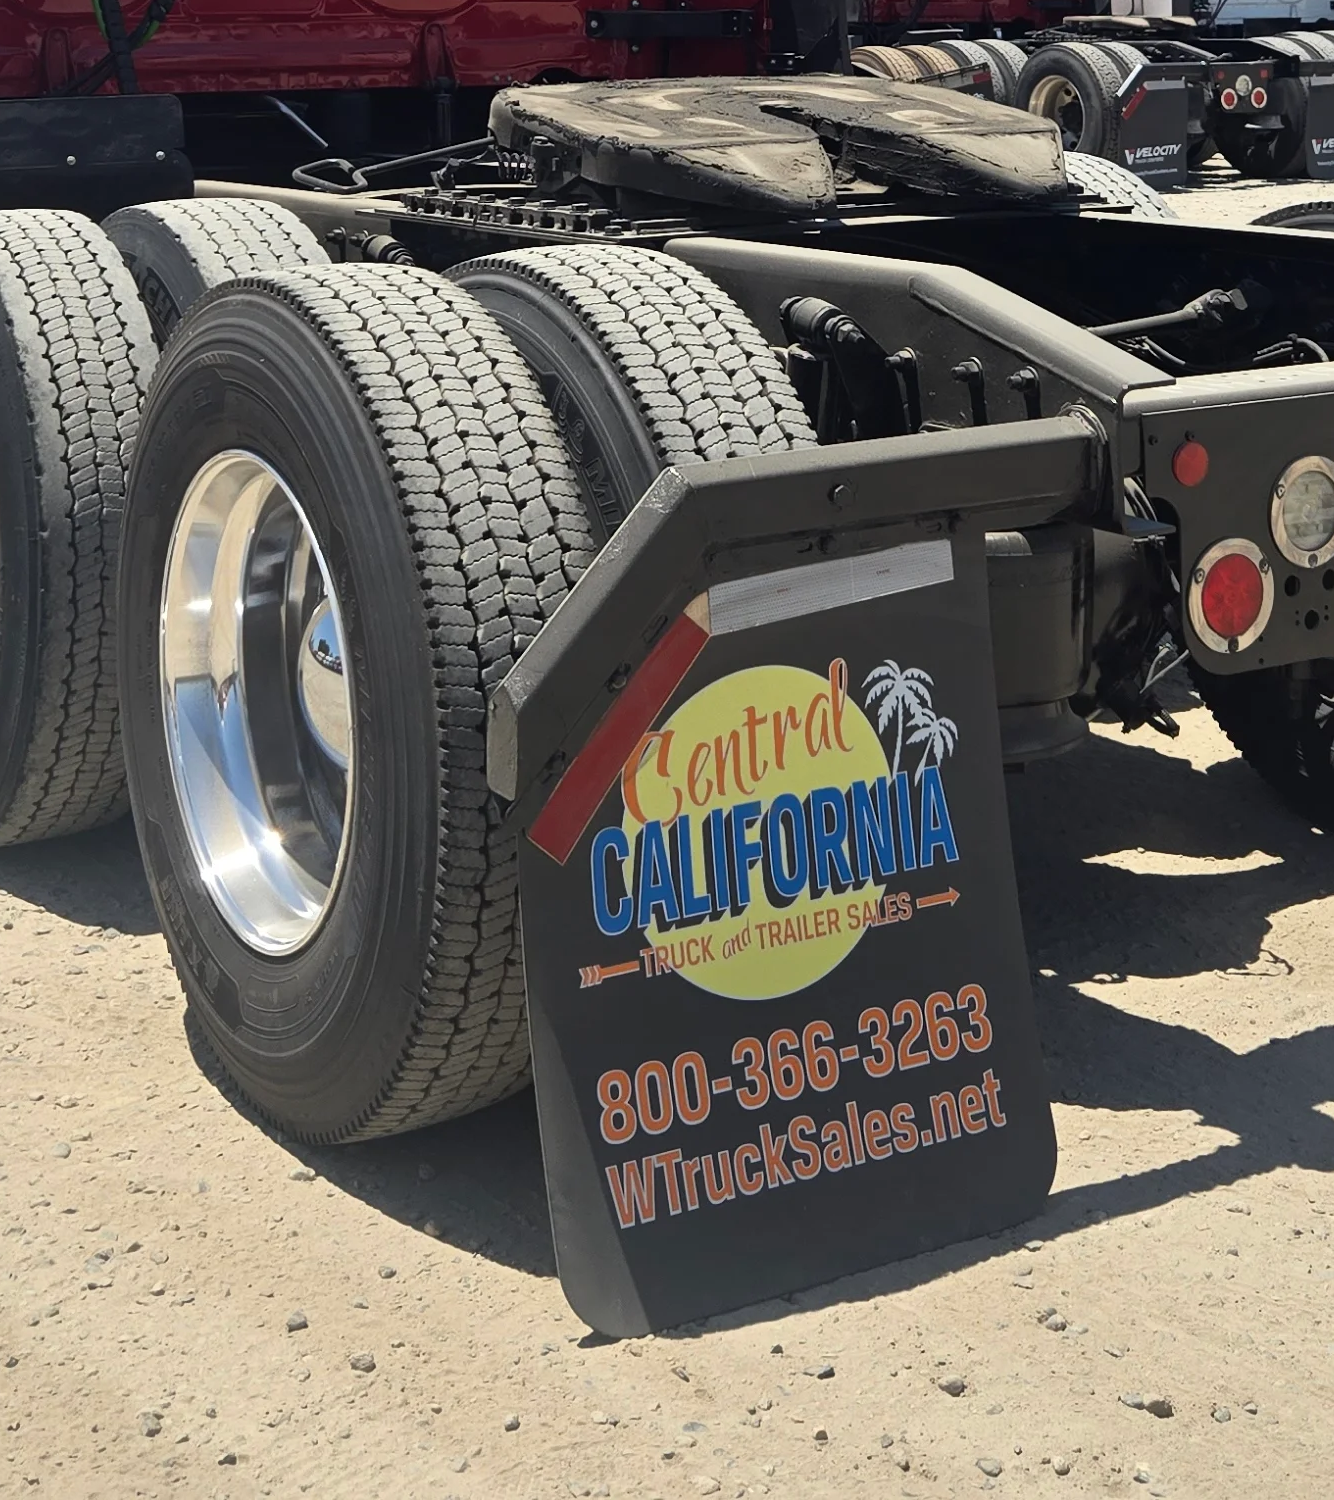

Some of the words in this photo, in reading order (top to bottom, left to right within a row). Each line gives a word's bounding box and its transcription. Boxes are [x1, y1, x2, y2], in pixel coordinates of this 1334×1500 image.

[1136, 144, 1182, 158] VELOCITY
[623, 657, 853, 826] Central
[589, 764, 960, 937] CALIFORNIA
[640, 937, 716, 979] TRUCK
[723, 926, 752, 963] and
[755, 910, 843, 950] TRAILER
[847, 892, 914, 932] SALES
[596, 982, 995, 1146] 800-366-3263
[605, 1069, 1007, 1231] WTruckSales.net
